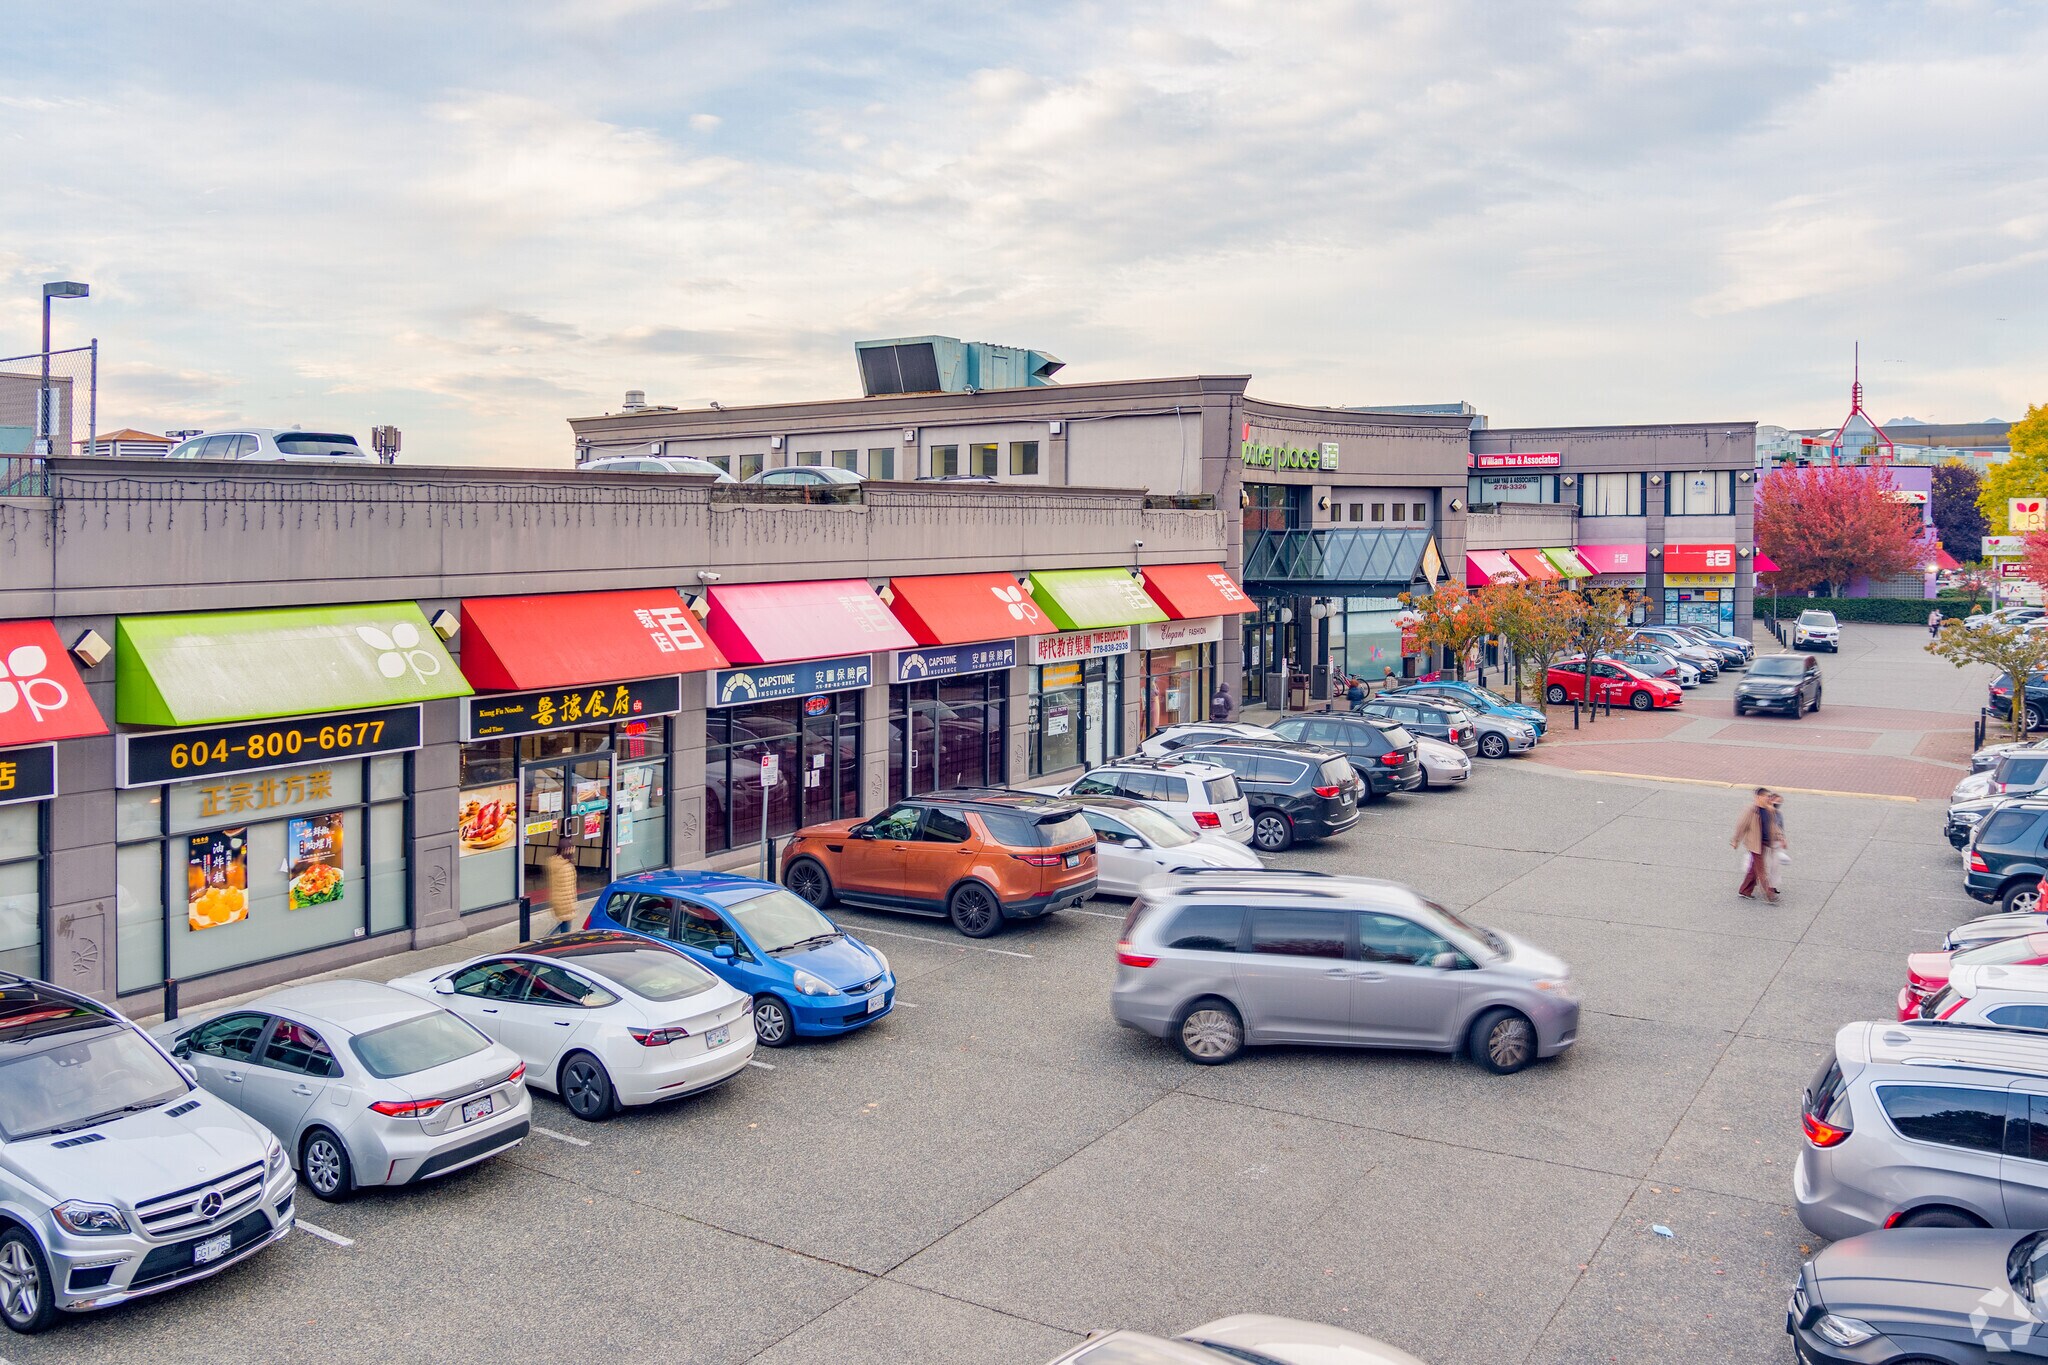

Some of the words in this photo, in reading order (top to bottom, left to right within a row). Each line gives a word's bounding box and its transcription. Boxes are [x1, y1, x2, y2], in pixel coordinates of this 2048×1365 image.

[1278, 441, 1320, 473] place
[1480, 456, 1504, 466] William
[1504, 456, 1516, 465] Yau
[1516, 455, 1523, 465] &
[1523, 454, 1559, 465] Associates
[1588, 578, 1612, 588] parker
[1613, 578, 1636, 587] place
[1093, 632, 1104, 643] TIME
[1104, 630, 1129, 642] EDUCATION
[1160, 623, 1186, 645] Elegant
[1188, 627, 1207, 636] FASHION
[1093, 642, 1129, 654] 778-838-2938
[928, 655, 957, 667] CAPSTONE
[928, 667, 957, 675] INSURANCE
[758, 673, 796, 688] CAPSTONE
[758, 687, 796, 698] INSURANCE
[805, 697, 829, 712] OPEN
[479, 708, 495, 719] Kung
[495, 706, 504, 716] Fu
[504, 705, 524, 714] Noodle
[479, 727, 492, 735] Good
[627, 722, 647, 736] OPEN
[170, 720, 385, 769] 604-800-6677
[199, 769, 333, 818] 正宗北方菜
[212, 841, 225, 883] 油炸糕
